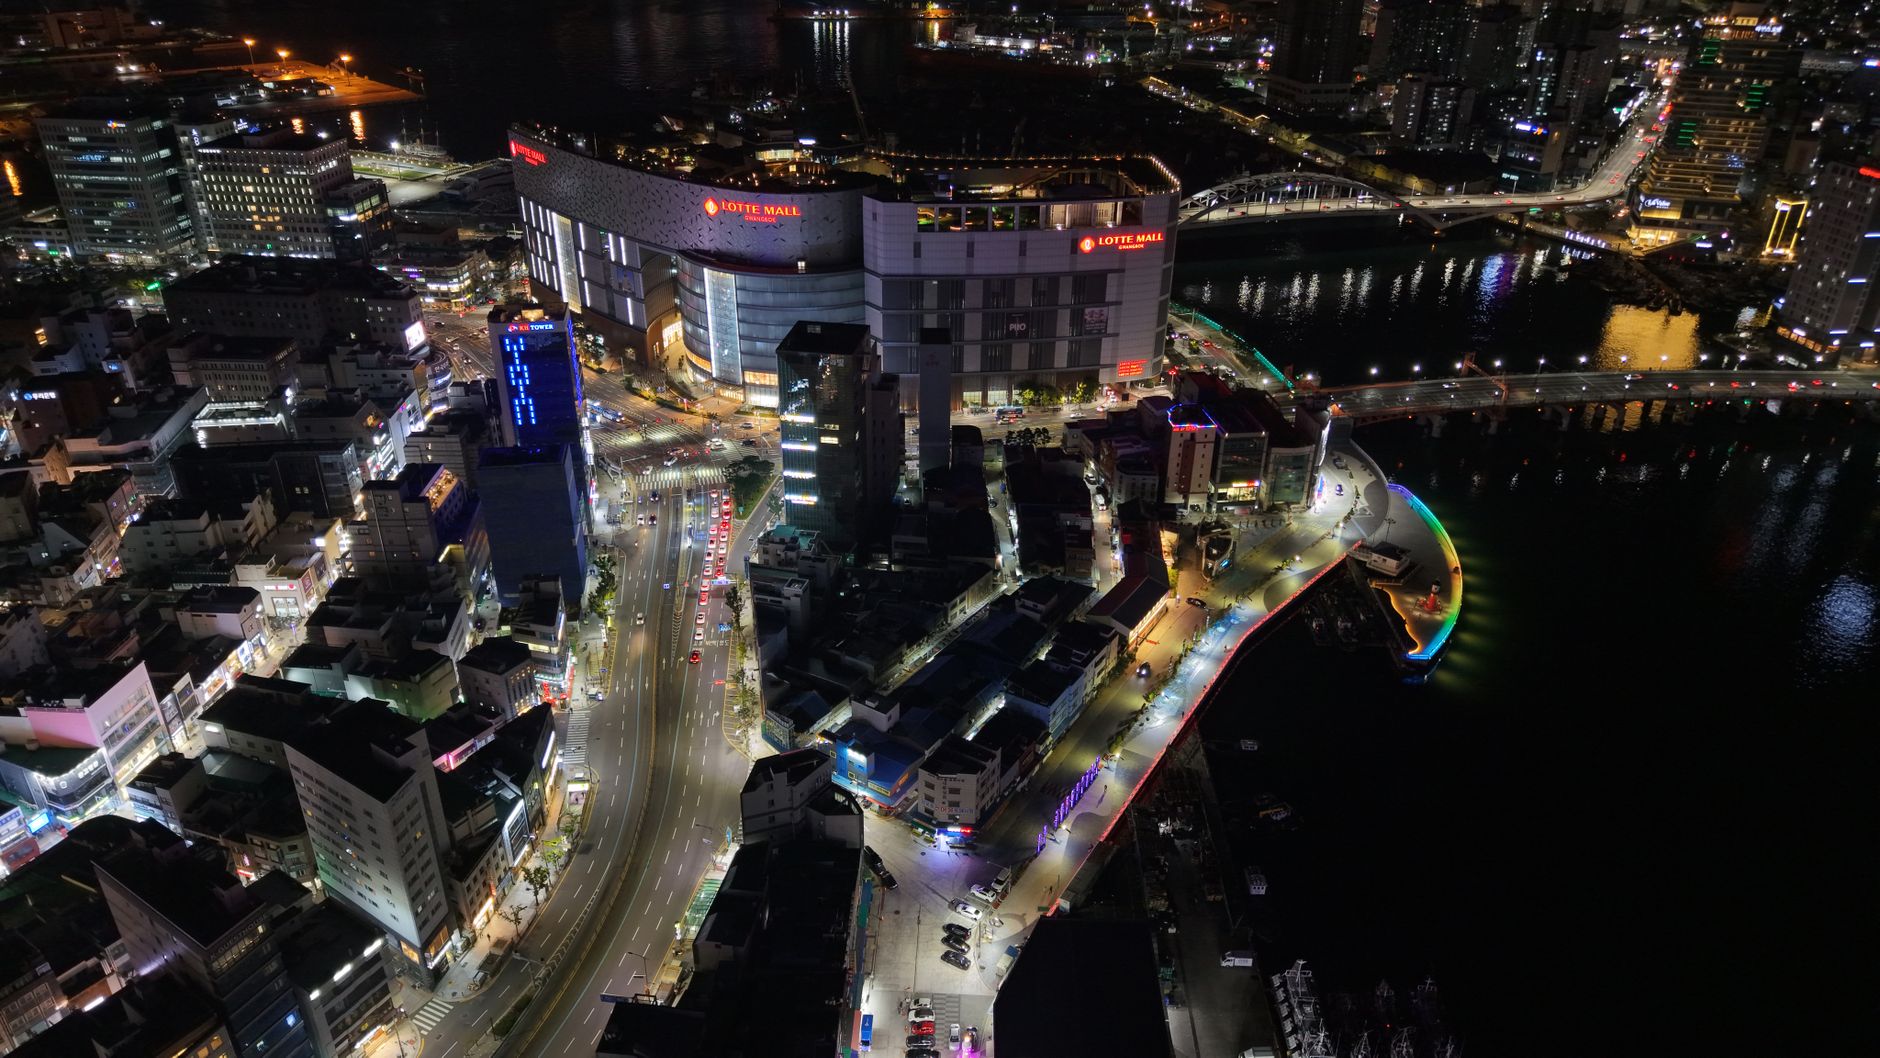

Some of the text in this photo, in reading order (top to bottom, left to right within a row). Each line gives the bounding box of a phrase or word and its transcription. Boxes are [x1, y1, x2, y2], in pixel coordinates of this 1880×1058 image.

[515, 143, 531, 157] LOTTE
[530, 150, 546, 163] MALL
[721, 201, 801, 216] LOTTE MALL
[1099, 232, 1164, 245] LOTTE MALL
